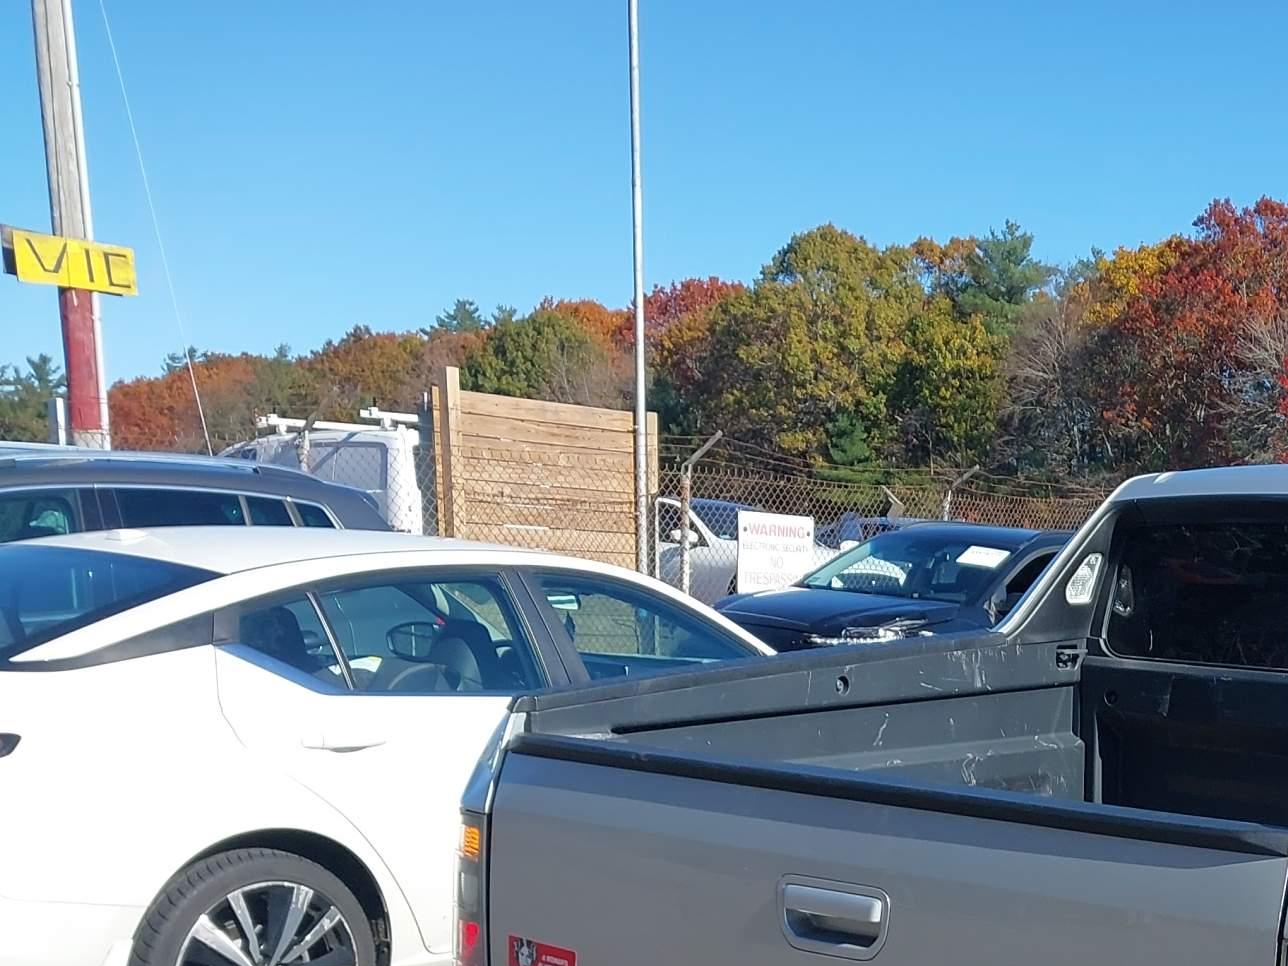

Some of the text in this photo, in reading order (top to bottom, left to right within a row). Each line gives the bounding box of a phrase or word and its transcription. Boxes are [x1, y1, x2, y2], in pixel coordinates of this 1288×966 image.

[25, 238, 131, 288] VIC
[748, 522, 806, 539] WARNING
[770, 556, 784, 569] NO
[744, 571, 801, 586] TRESPASSI
